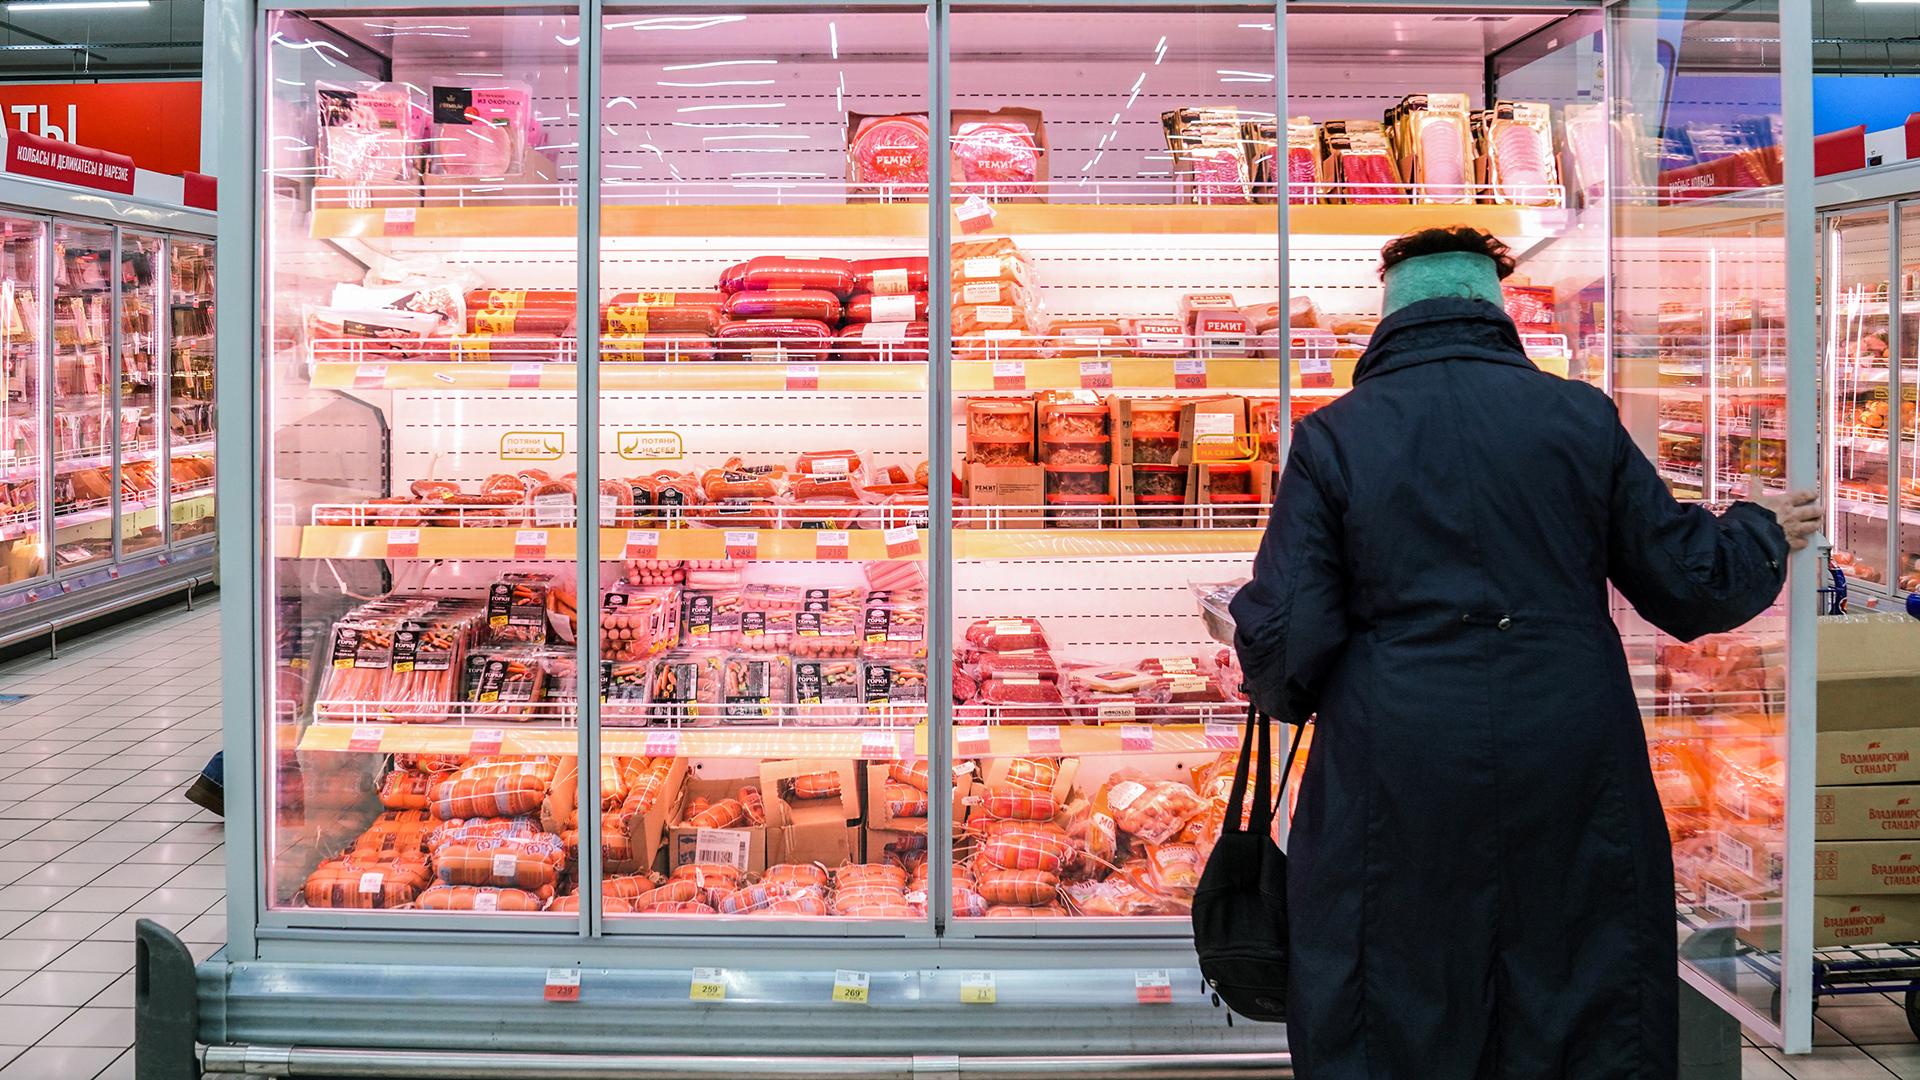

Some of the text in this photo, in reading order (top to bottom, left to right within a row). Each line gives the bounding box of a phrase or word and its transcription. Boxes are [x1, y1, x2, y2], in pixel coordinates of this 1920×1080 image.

[0, 104, 77, 144] ТЫ
[17, 146, 129, 182] КОЛБАСЫ И ДЕЛИКАТЕСЫ В НАРЕЗКЕ
[877, 155, 912, 165] РЕМИТ
[978, 160, 1013, 169] РЕМИТ
[1207, 321, 1242, 331] РЕМИТ
[1840, 750, 1910, 764] ВЛАДИМИРСКИЙ
[1854, 763, 1897, 774] СТАНДАРТ
[1824, 914, 1885, 928] ВЛАДИМИРСКИЙ
[1834, 926, 1873, 938] СТАНДАРТ
[702, 985, 718, 993] 259
[845, 988, 861, 997] 269
